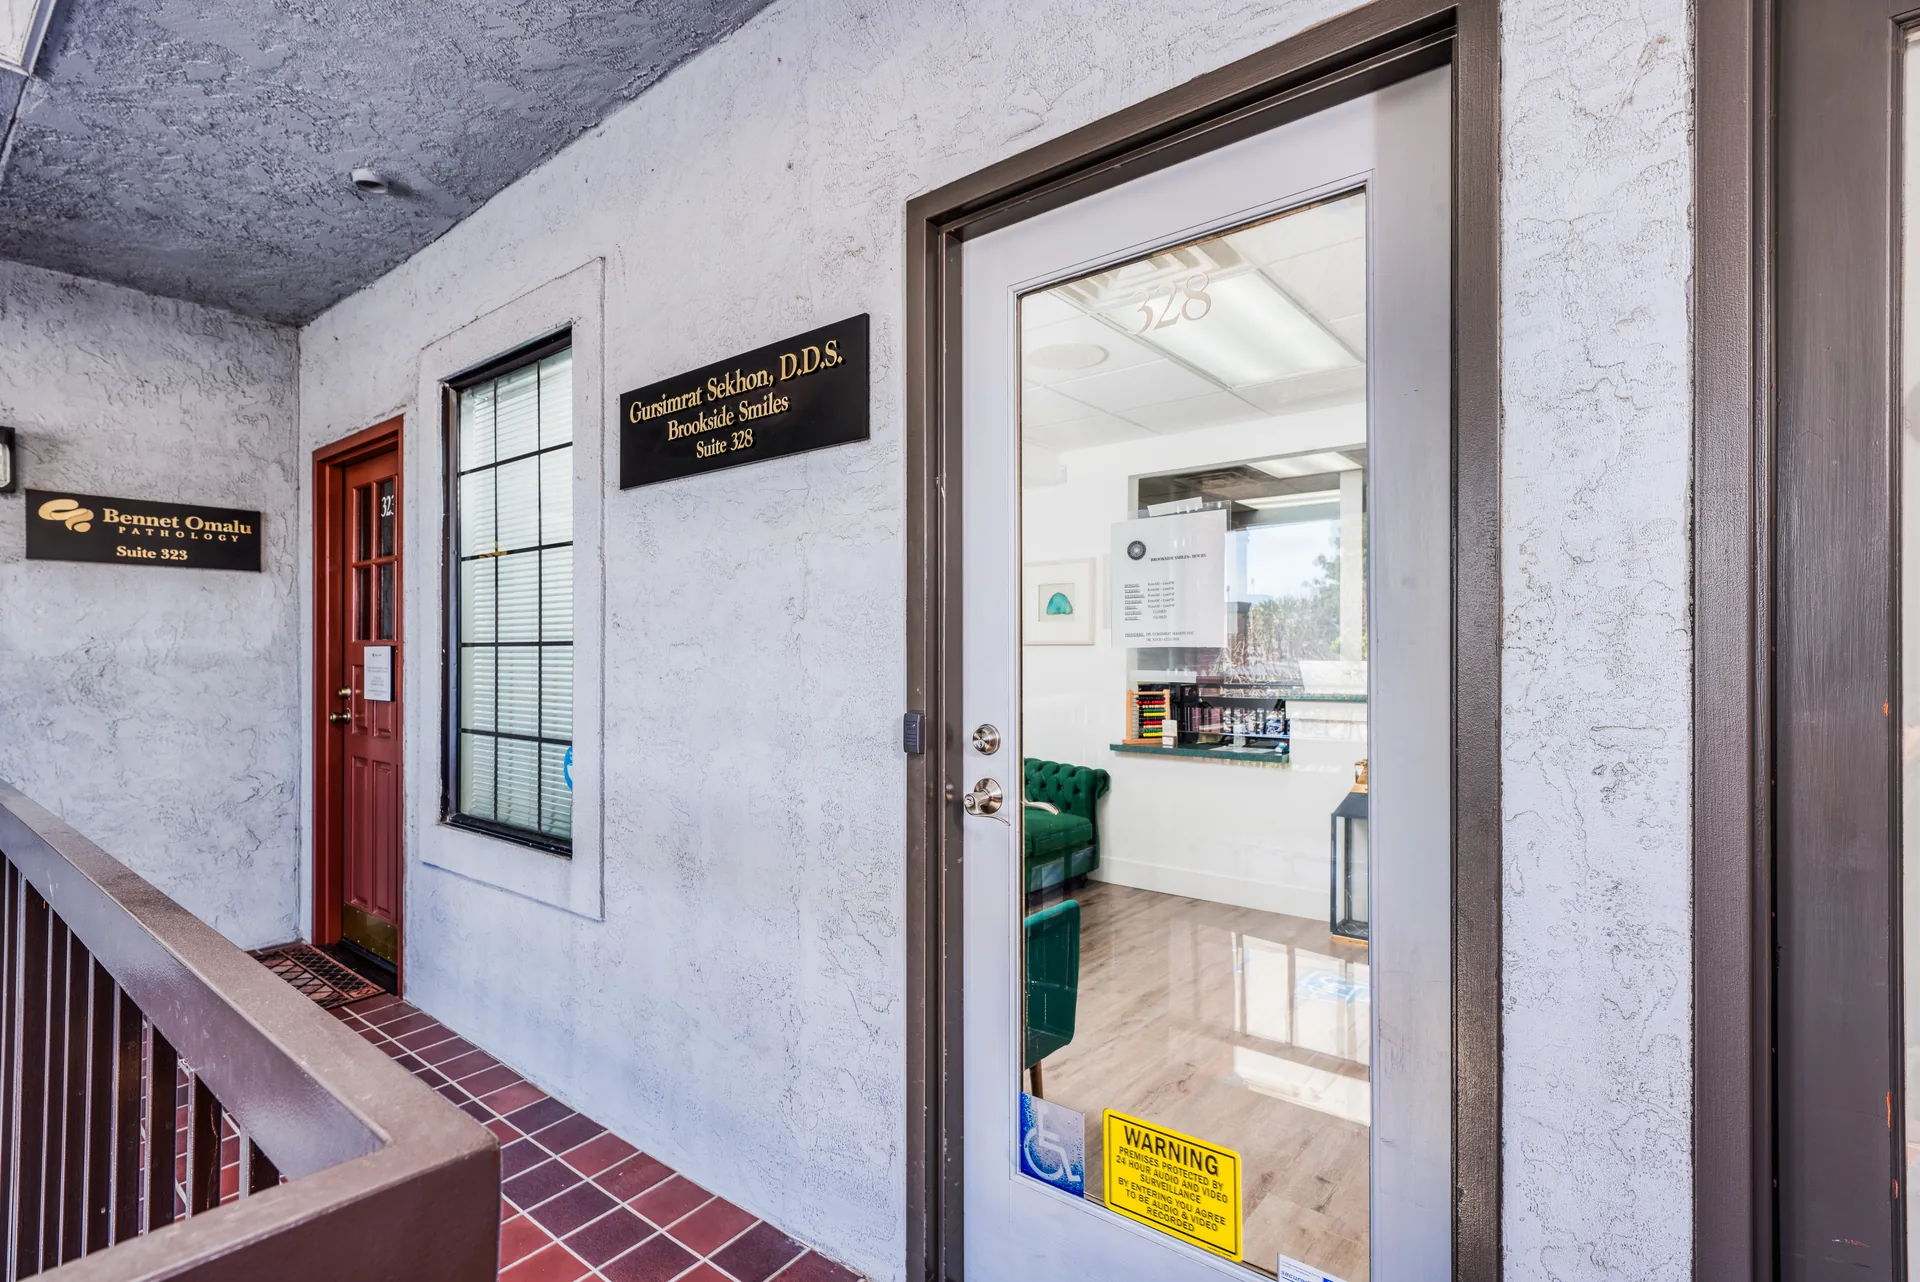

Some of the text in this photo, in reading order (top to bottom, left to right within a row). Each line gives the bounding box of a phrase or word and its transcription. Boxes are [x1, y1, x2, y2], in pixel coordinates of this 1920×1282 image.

[1128, 272, 1212, 336] 328
[629, 339, 844, 424] Gursimrat Sekhon, D.D.S.
[667, 391, 789, 441] Brookside Smiles
[696, 428, 754, 459] Suite 328
[102, 508, 252, 535] Bennet Omalu
[118, 526, 240, 543] PATHOLOGY
[116, 545, 189, 561] Suite 323
[1119, 1146, 1224, 1191] PREMISES PROTECTED BY
[1123, 1125, 1219, 1177] WARNING
[1115, 1155, 1228, 1204] 24 HOUR AUDIO AND VIDEO
[1118, 1176, 1226, 1226] BY ENTERING YOU AGREE
[1139, 1173, 1202, 1204] SURVEILLANCE
[1125, 1188, 1218, 1232] TO BE AUDIO & VIDEO
[1146, 1206, 1195, 1232] RECORDED
